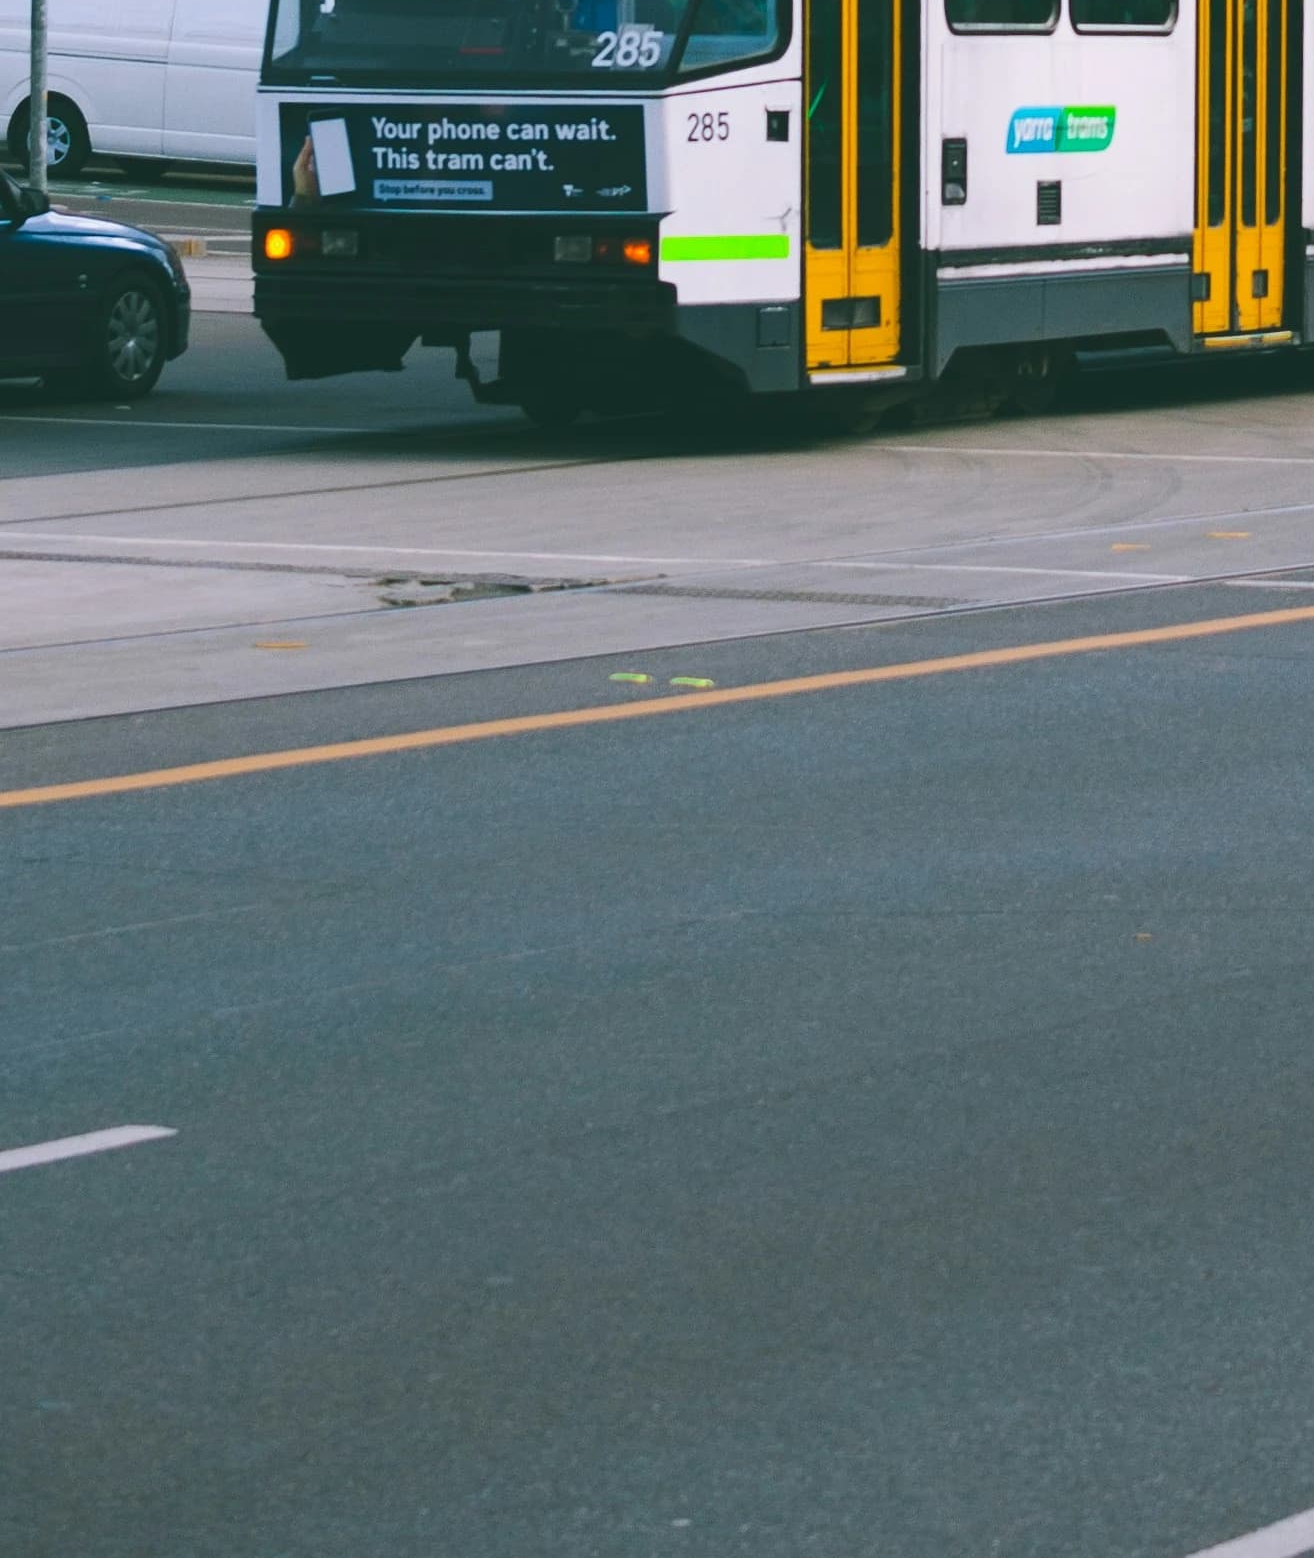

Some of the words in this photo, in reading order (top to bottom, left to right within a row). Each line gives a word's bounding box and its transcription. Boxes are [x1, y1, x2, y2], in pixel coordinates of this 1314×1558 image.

[592, 31, 664, 67] 285
[372, 117, 421, 140] Your
[428, 118, 500, 145] phone
[506, 122, 549, 140] can
[554, 118, 617, 141] wait.
[687, 112, 730, 142] 285
[1013, 116, 1054, 148] yarra
[1067, 112, 1108, 140] trams
[372, 147, 420, 170] This
[426, 149, 484, 170] tram
[490, 148, 555, 171] can't.
[379, 184, 400, 196] Stop
[402, 184, 436, 195] before
[437, 187, 456, 197] you
